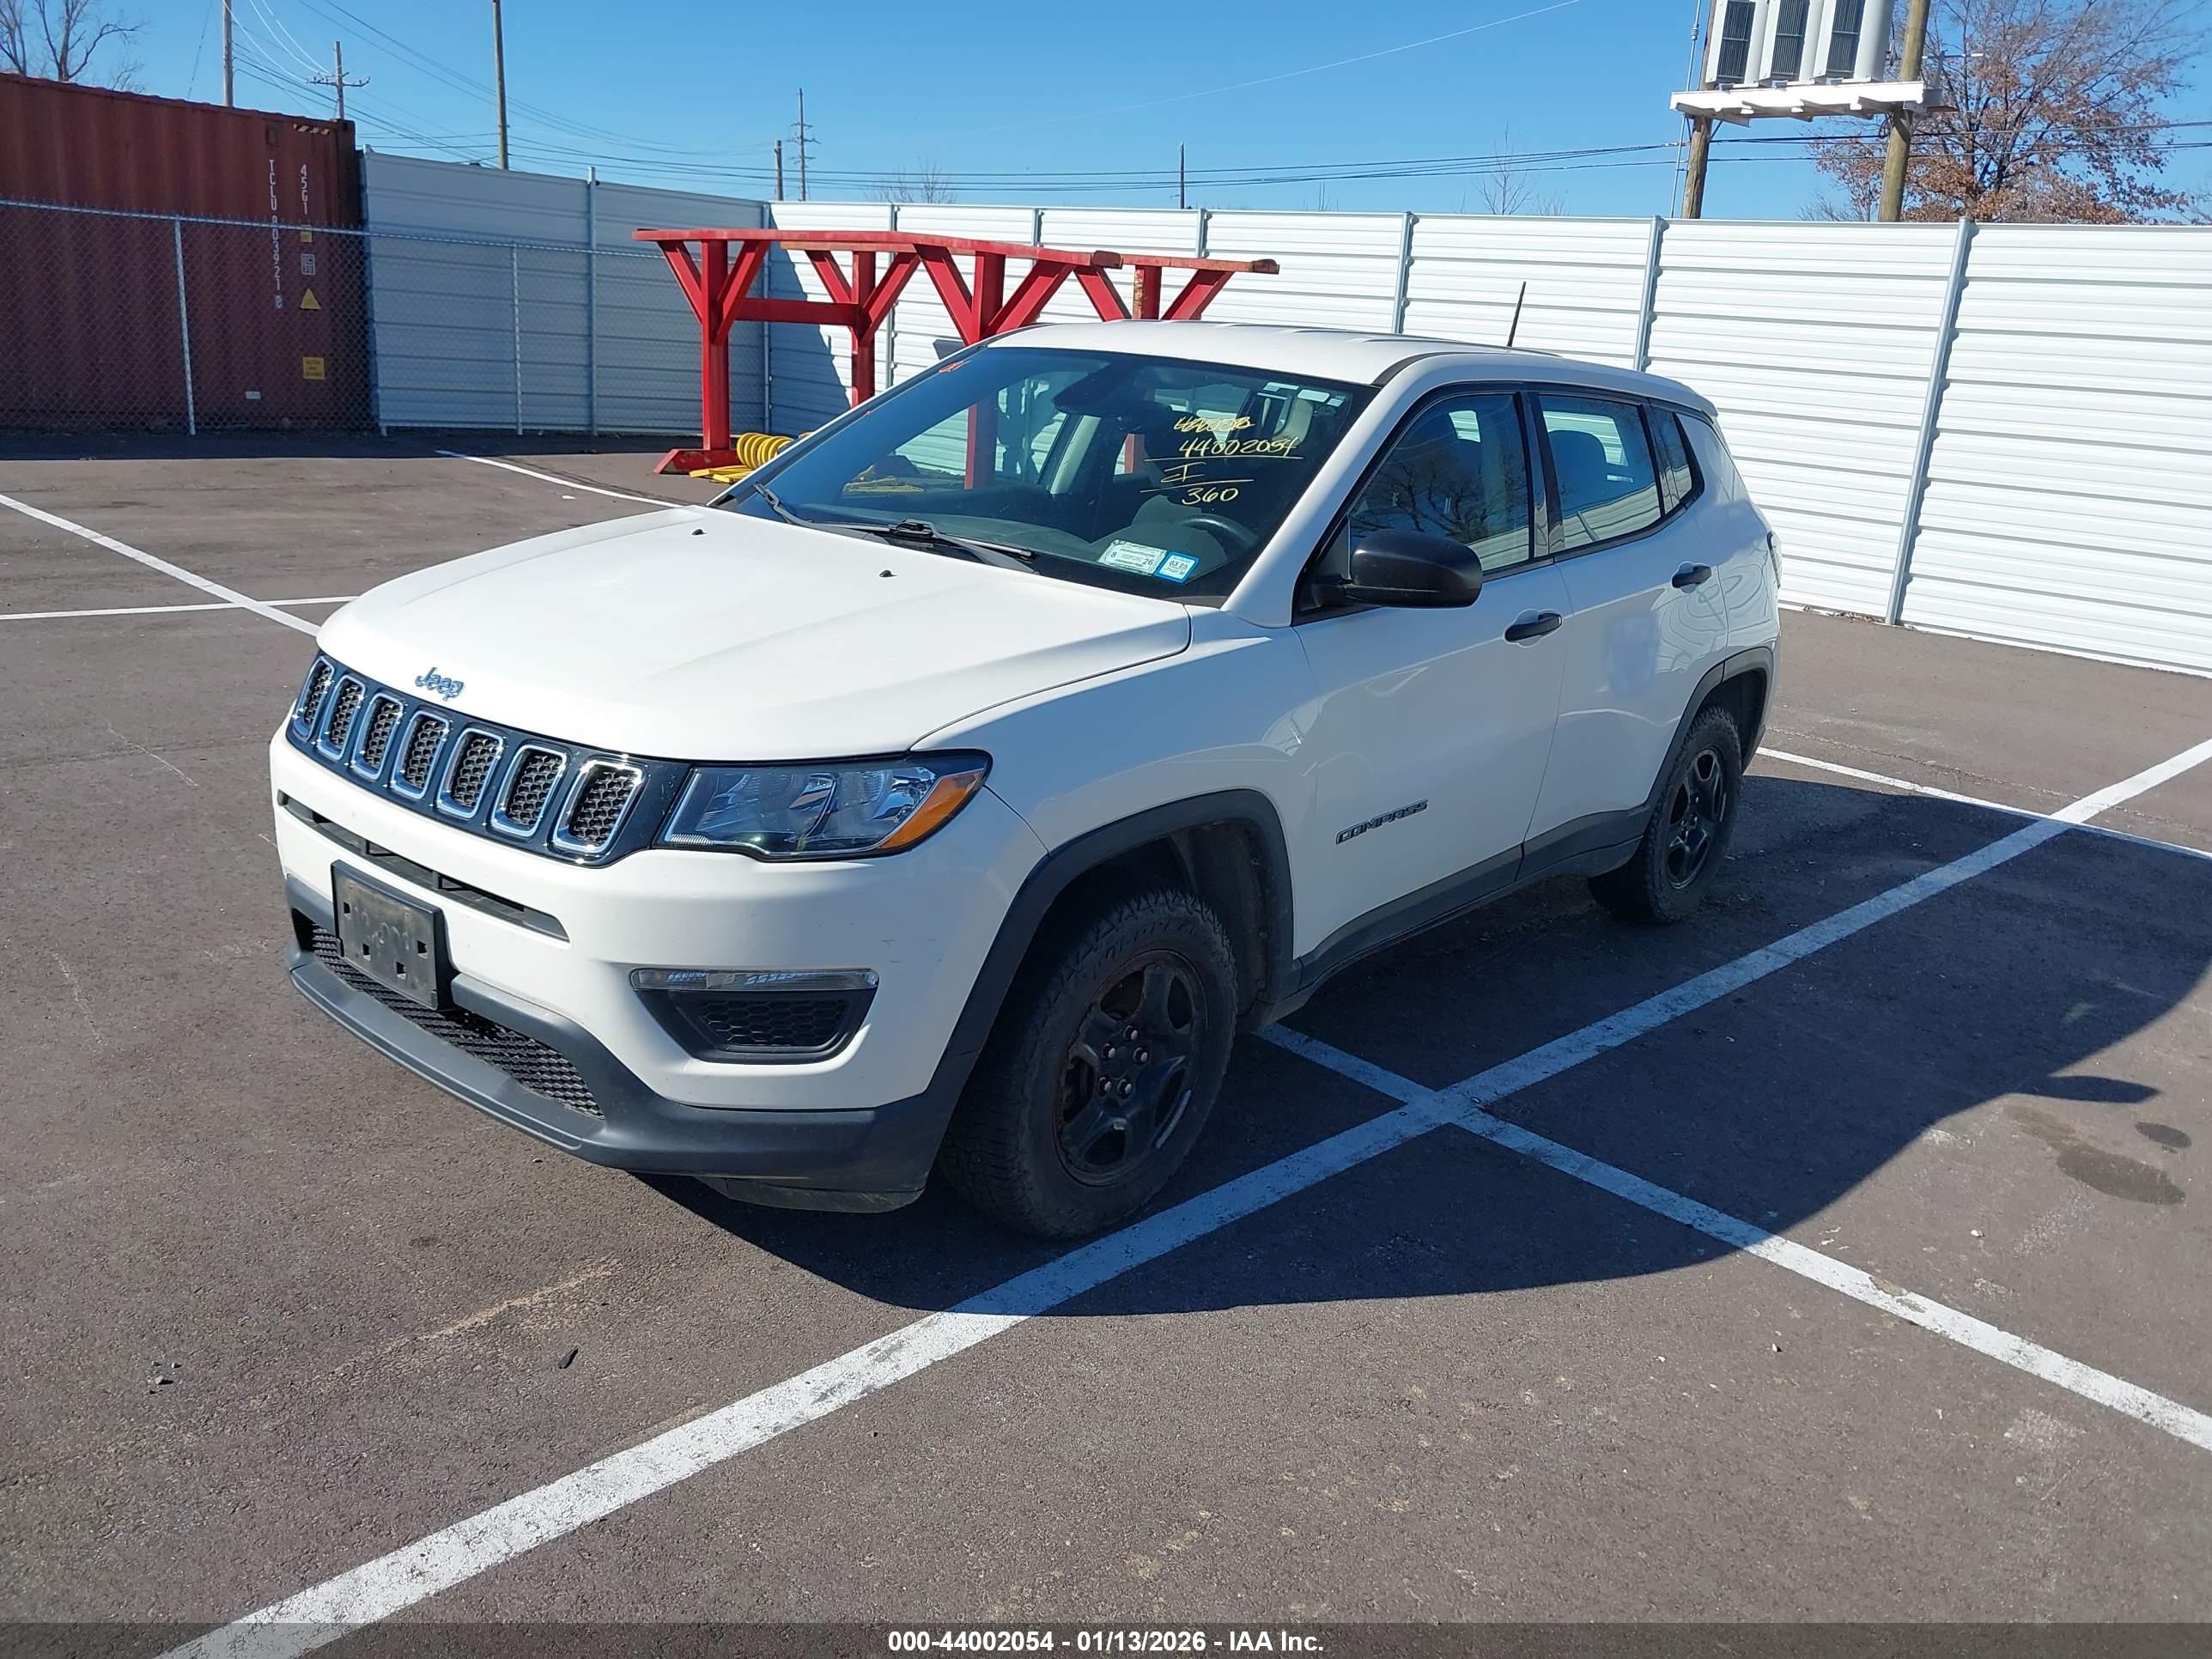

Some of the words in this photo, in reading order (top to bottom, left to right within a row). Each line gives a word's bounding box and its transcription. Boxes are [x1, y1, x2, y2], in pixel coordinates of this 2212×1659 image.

[269, 160, 277, 211] TCLU
[1179, 436, 1299, 458] 44002054
[1182, 487, 1239, 505] 360
[1142, 557, 1155, 566] 26
[415, 666, 465, 702] Jeep
[1336, 799, 1428, 845] COMPASS
